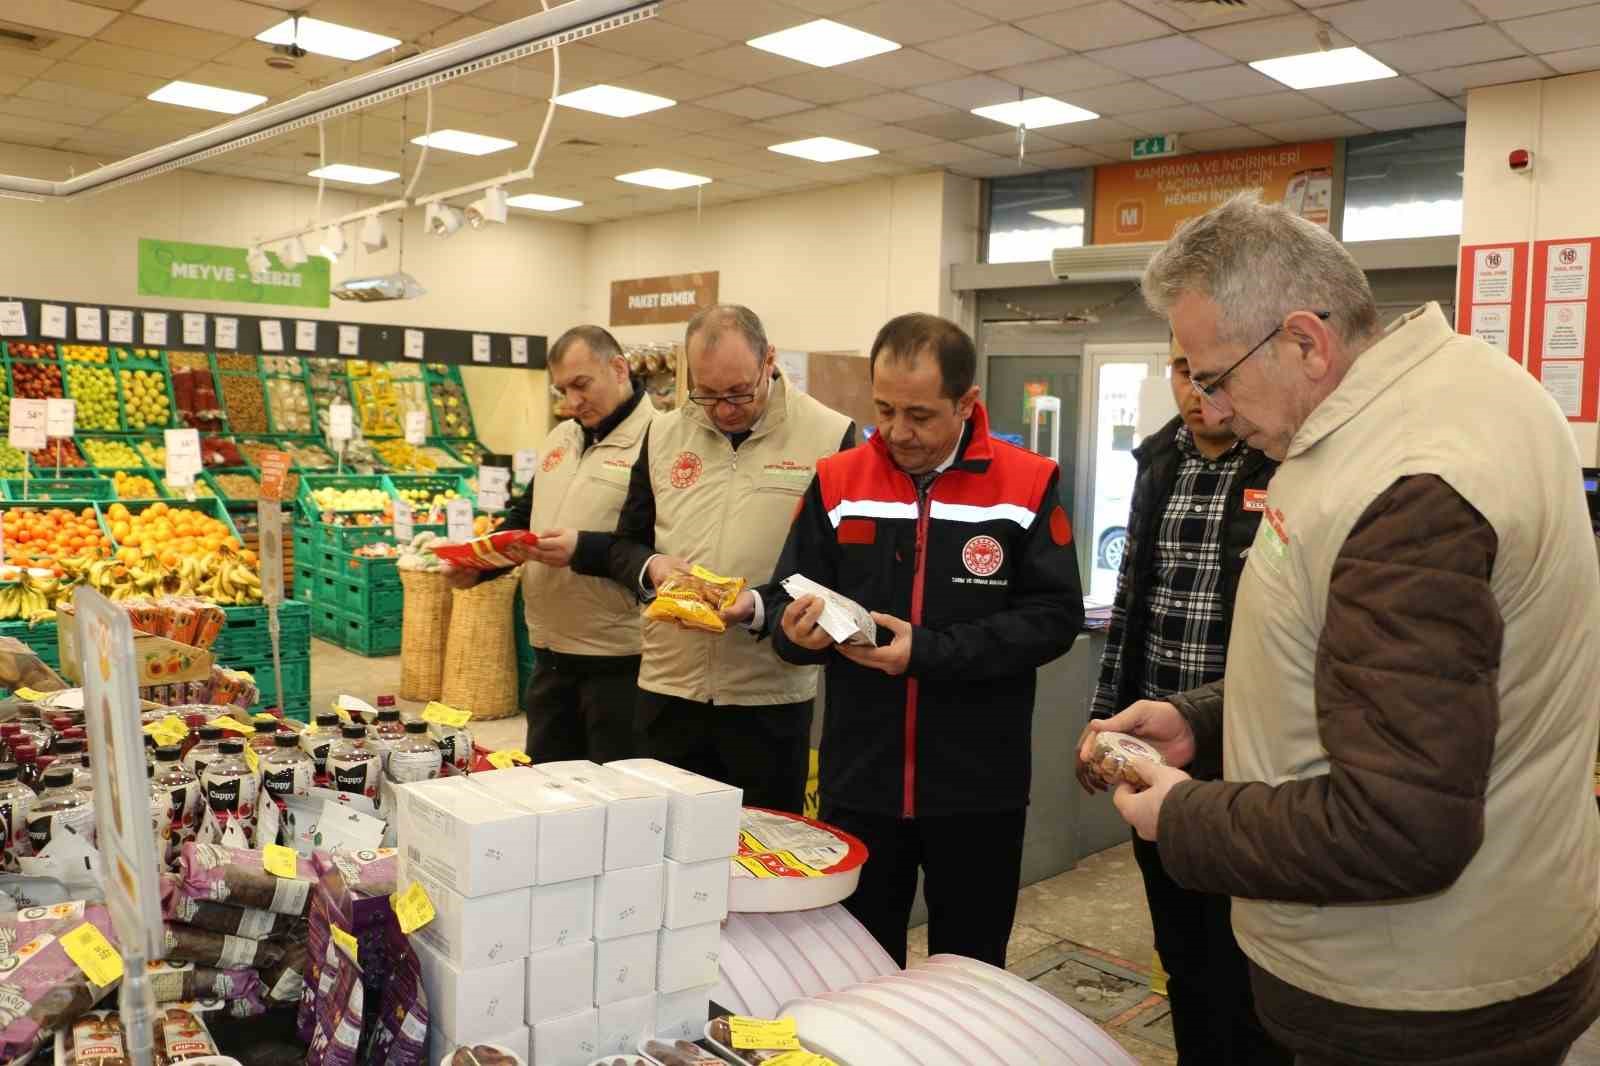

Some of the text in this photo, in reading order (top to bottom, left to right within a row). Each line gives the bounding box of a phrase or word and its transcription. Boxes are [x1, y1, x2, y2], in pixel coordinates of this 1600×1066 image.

[1135, 151, 1300, 179] KAMPANYA VE İNDİRİMLERİ
[1157, 169, 1272, 193] KAÇIRMAMAK İÇİN
[1164, 190, 1206, 206] HEMEN
[1120, 208, 1138, 225] M
[171, 262, 235, 282] MEYVE
[628, 289, 696, 309] PAKET EKMEK
[266, 781, 290, 790] Cappy
[338, 775, 364, 784] Cappy
[210, 790, 236, 800] Cappy
